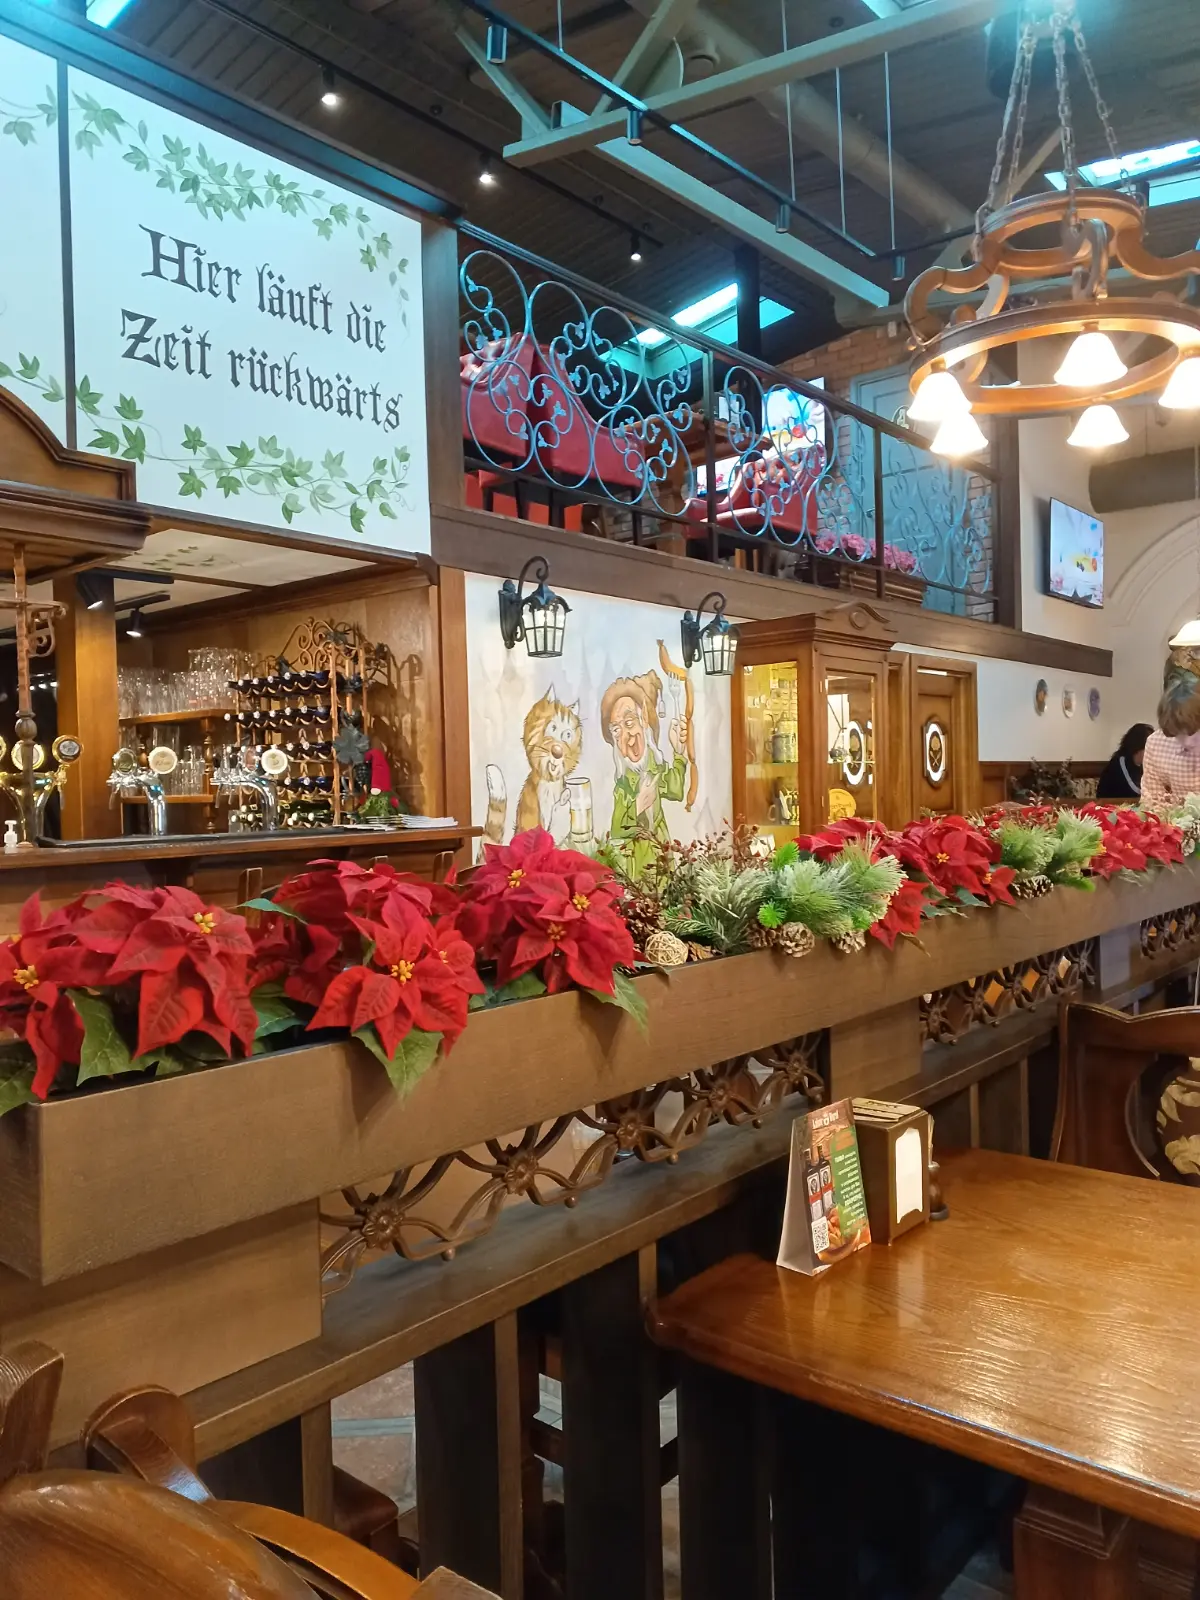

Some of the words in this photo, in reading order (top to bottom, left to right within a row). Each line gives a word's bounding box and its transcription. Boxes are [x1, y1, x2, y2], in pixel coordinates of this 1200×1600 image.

[138, 223, 242, 303] Hier
[256, 263, 333, 334] läuft
[346, 301, 387, 352] die
[120, 308, 212, 379] Zeit
[227, 347, 403, 433] rückwärts
